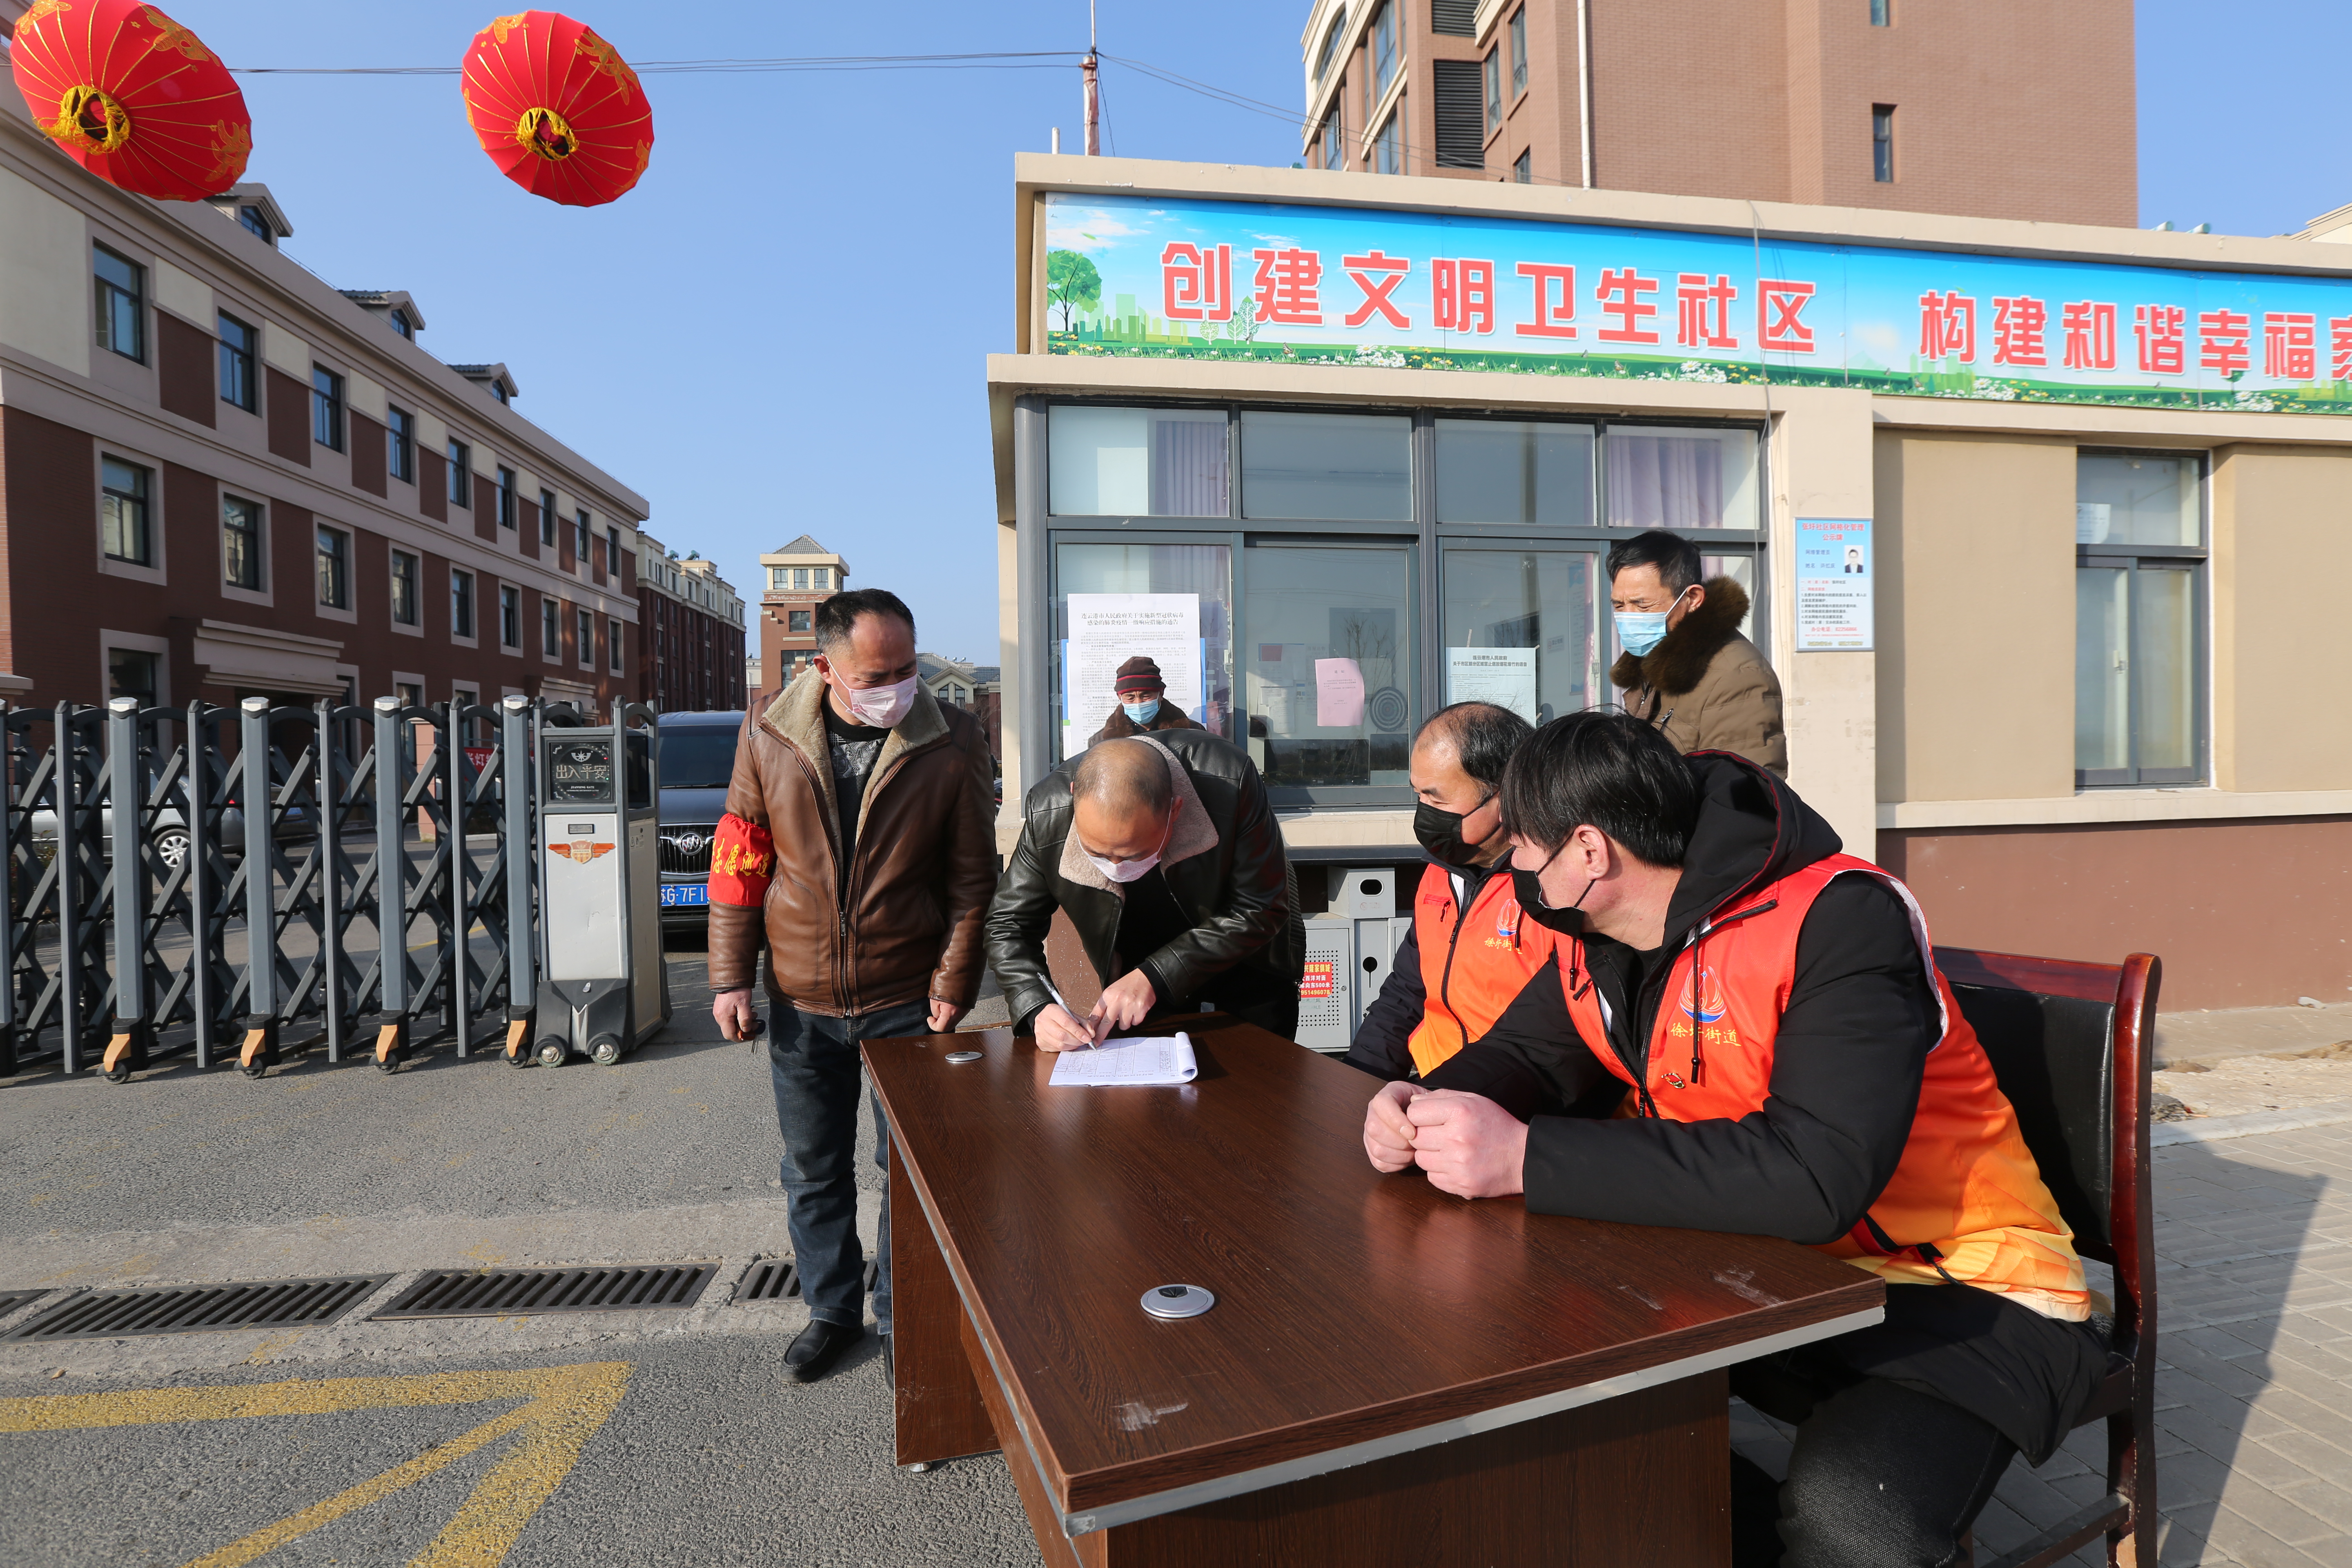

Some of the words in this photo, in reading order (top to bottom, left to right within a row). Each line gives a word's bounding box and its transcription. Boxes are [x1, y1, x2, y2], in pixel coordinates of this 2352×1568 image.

[1160, 241, 1817, 354] 创建文明卫生社区
[556, 764, 607, 779] 出入平安
[712, 838, 770, 878] 志愿巡逻
